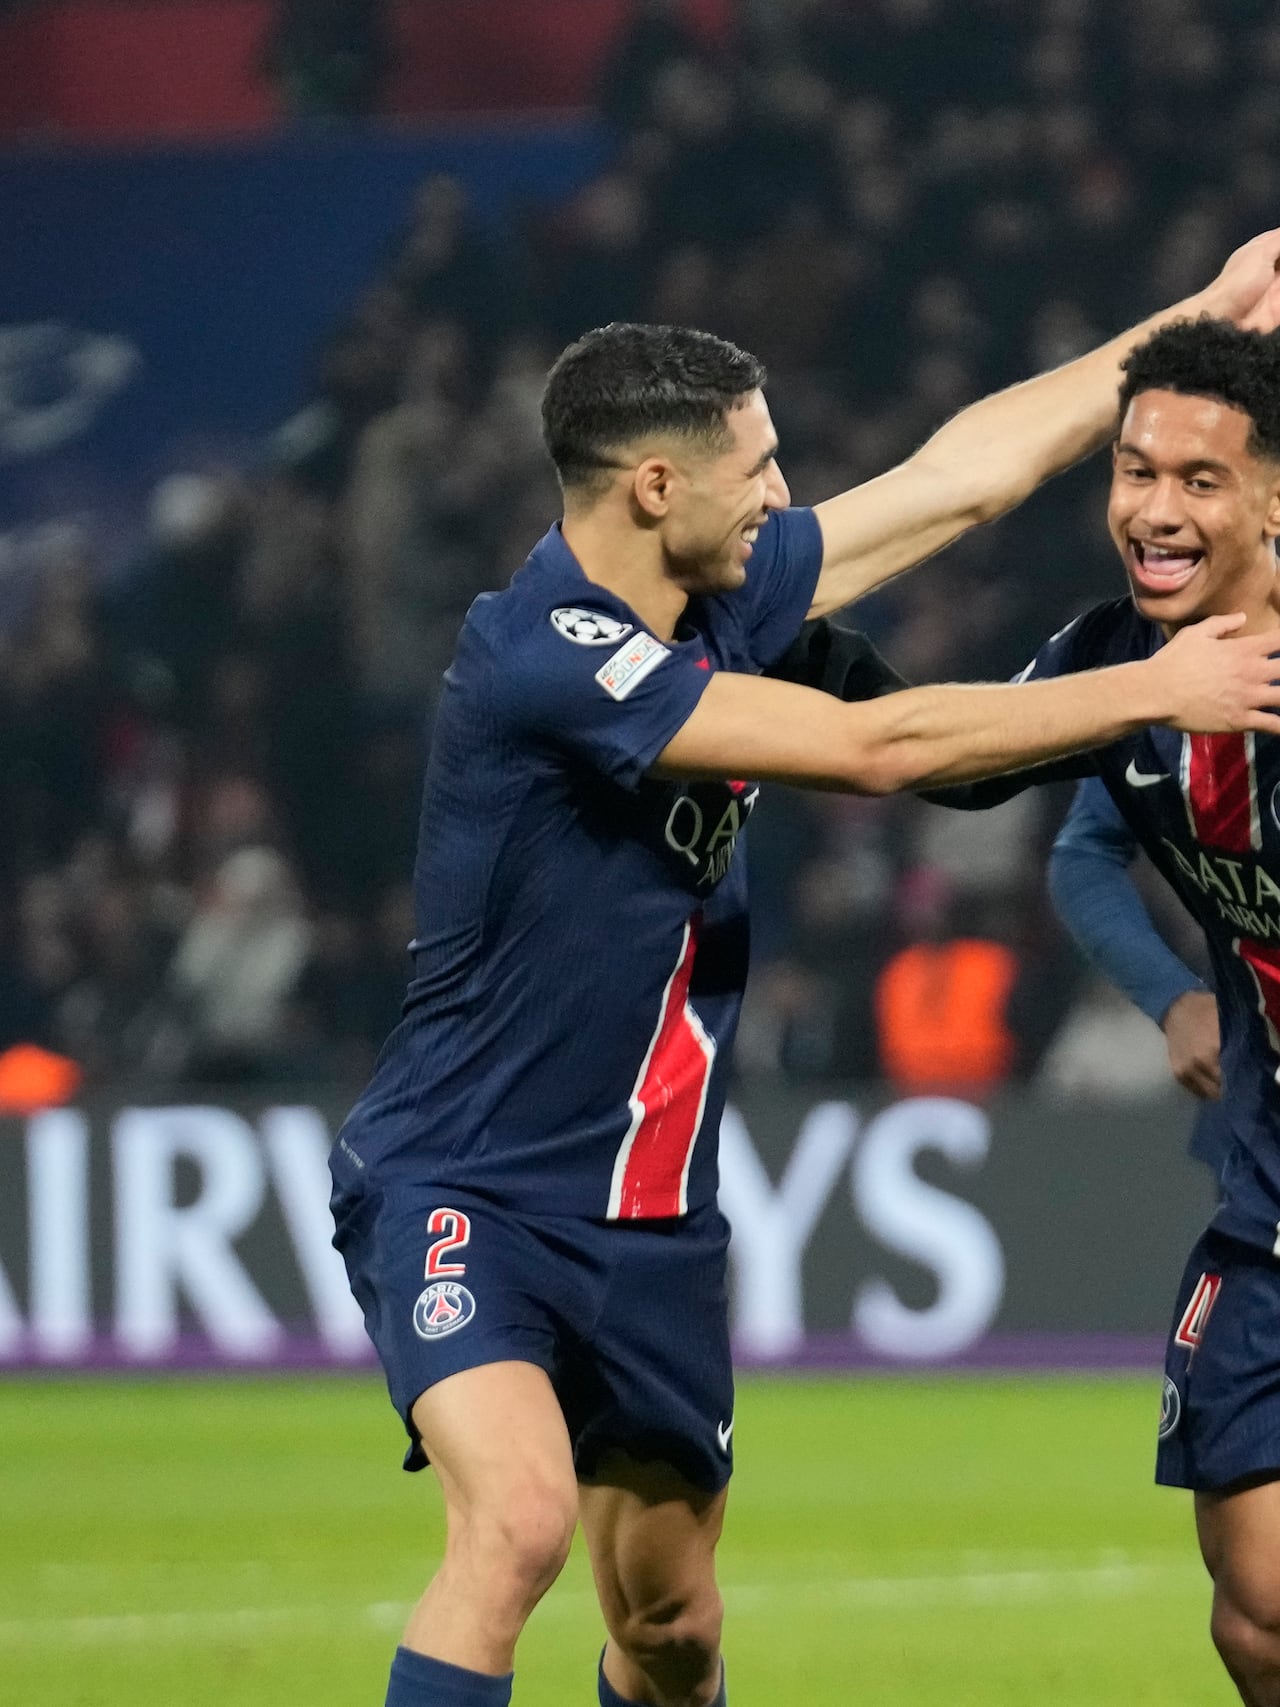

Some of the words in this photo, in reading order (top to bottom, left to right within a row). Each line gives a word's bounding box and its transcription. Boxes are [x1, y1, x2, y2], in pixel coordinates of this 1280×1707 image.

[424, 1206, 472, 1281] 2
[420, 1284, 462, 1305] PARIS
[1173, 1271, 1222, 1374] 4
